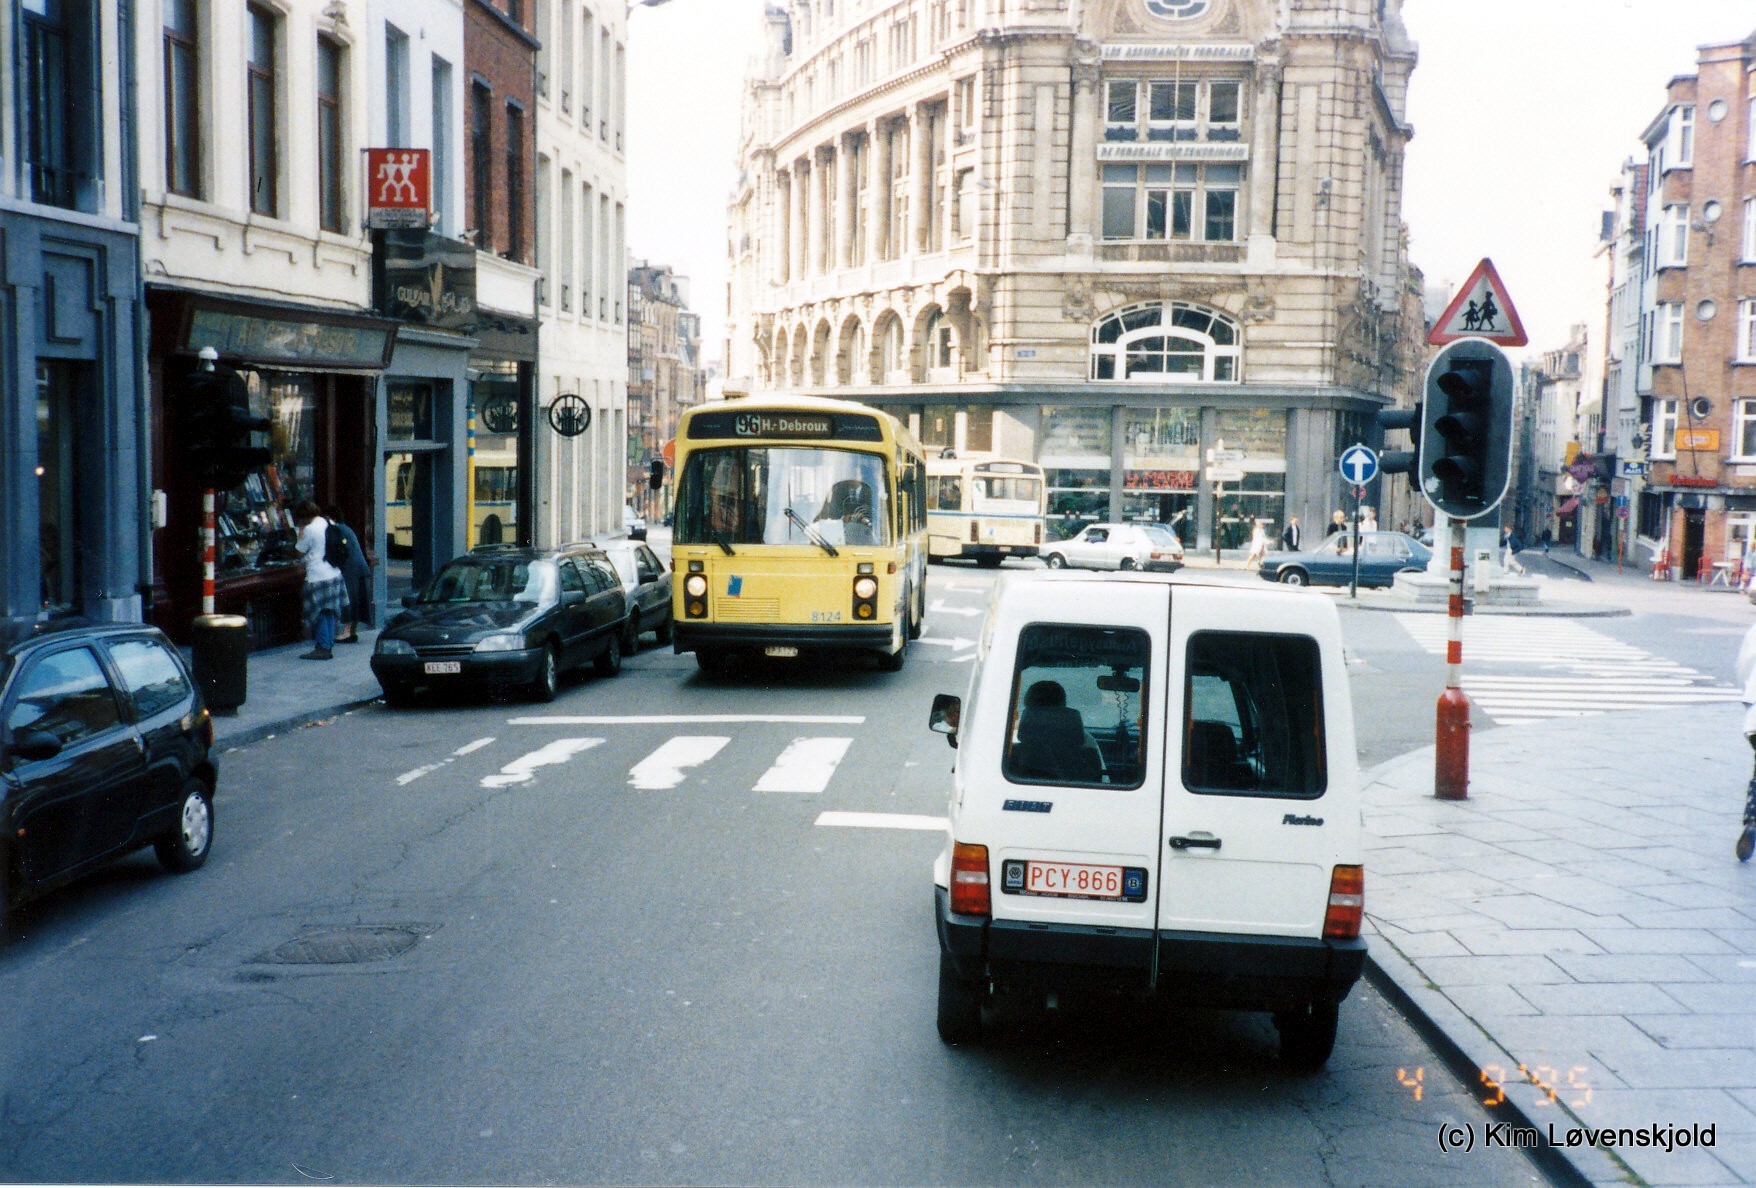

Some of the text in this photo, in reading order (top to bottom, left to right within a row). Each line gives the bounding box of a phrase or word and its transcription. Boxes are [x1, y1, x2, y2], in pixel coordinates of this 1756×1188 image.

[736, 416, 760, 435] 96
[1144, 471, 1194, 481] MAISON
[811, 611, 841, 622] 8124
